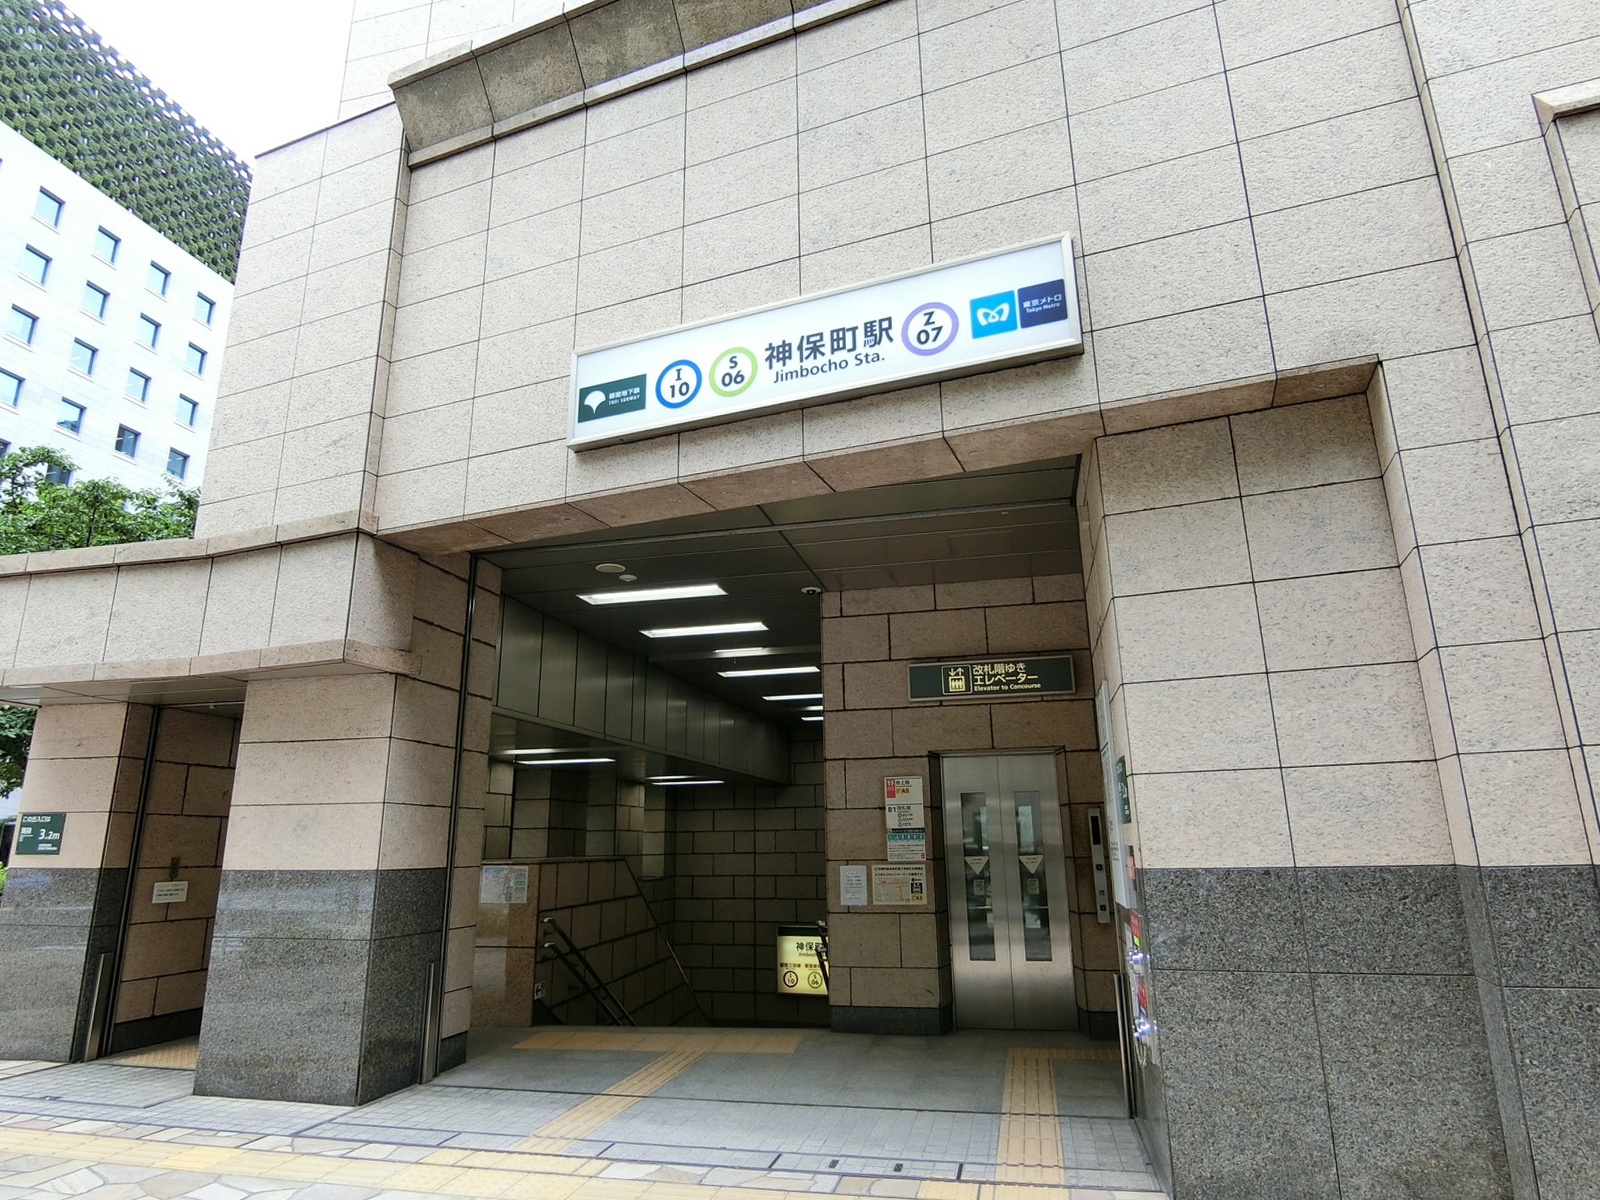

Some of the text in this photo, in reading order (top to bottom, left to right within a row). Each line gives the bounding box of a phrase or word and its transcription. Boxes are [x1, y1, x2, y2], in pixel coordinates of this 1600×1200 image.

[1022, 293, 1062, 309] 東京メトロ
[1025, 301, 1061, 314] Tokyo Metro
[923, 310, 936, 327] Z
[916, 325, 944, 345] 07
[764, 316, 894, 370] 神保町駅
[728, 355, 739, 370] S
[773, 351, 885, 384] Jimbocho Sta.
[675, 368, 683, 382] I
[721, 369, 745, 387] 06
[608, 386, 640, 400] 都営地下鉄
[669, 381, 690, 398] 10
[608, 393, 640, 406] TOEI SUBWAY
[972, 662, 1026, 676] 改札階ゆき
[973, 672, 1039, 686] エレベーター
[974, 684, 1000, 692] Elevator
[1009, 682, 1041, 690] Concourse
[38, 828, 60, 840] 3.2m
